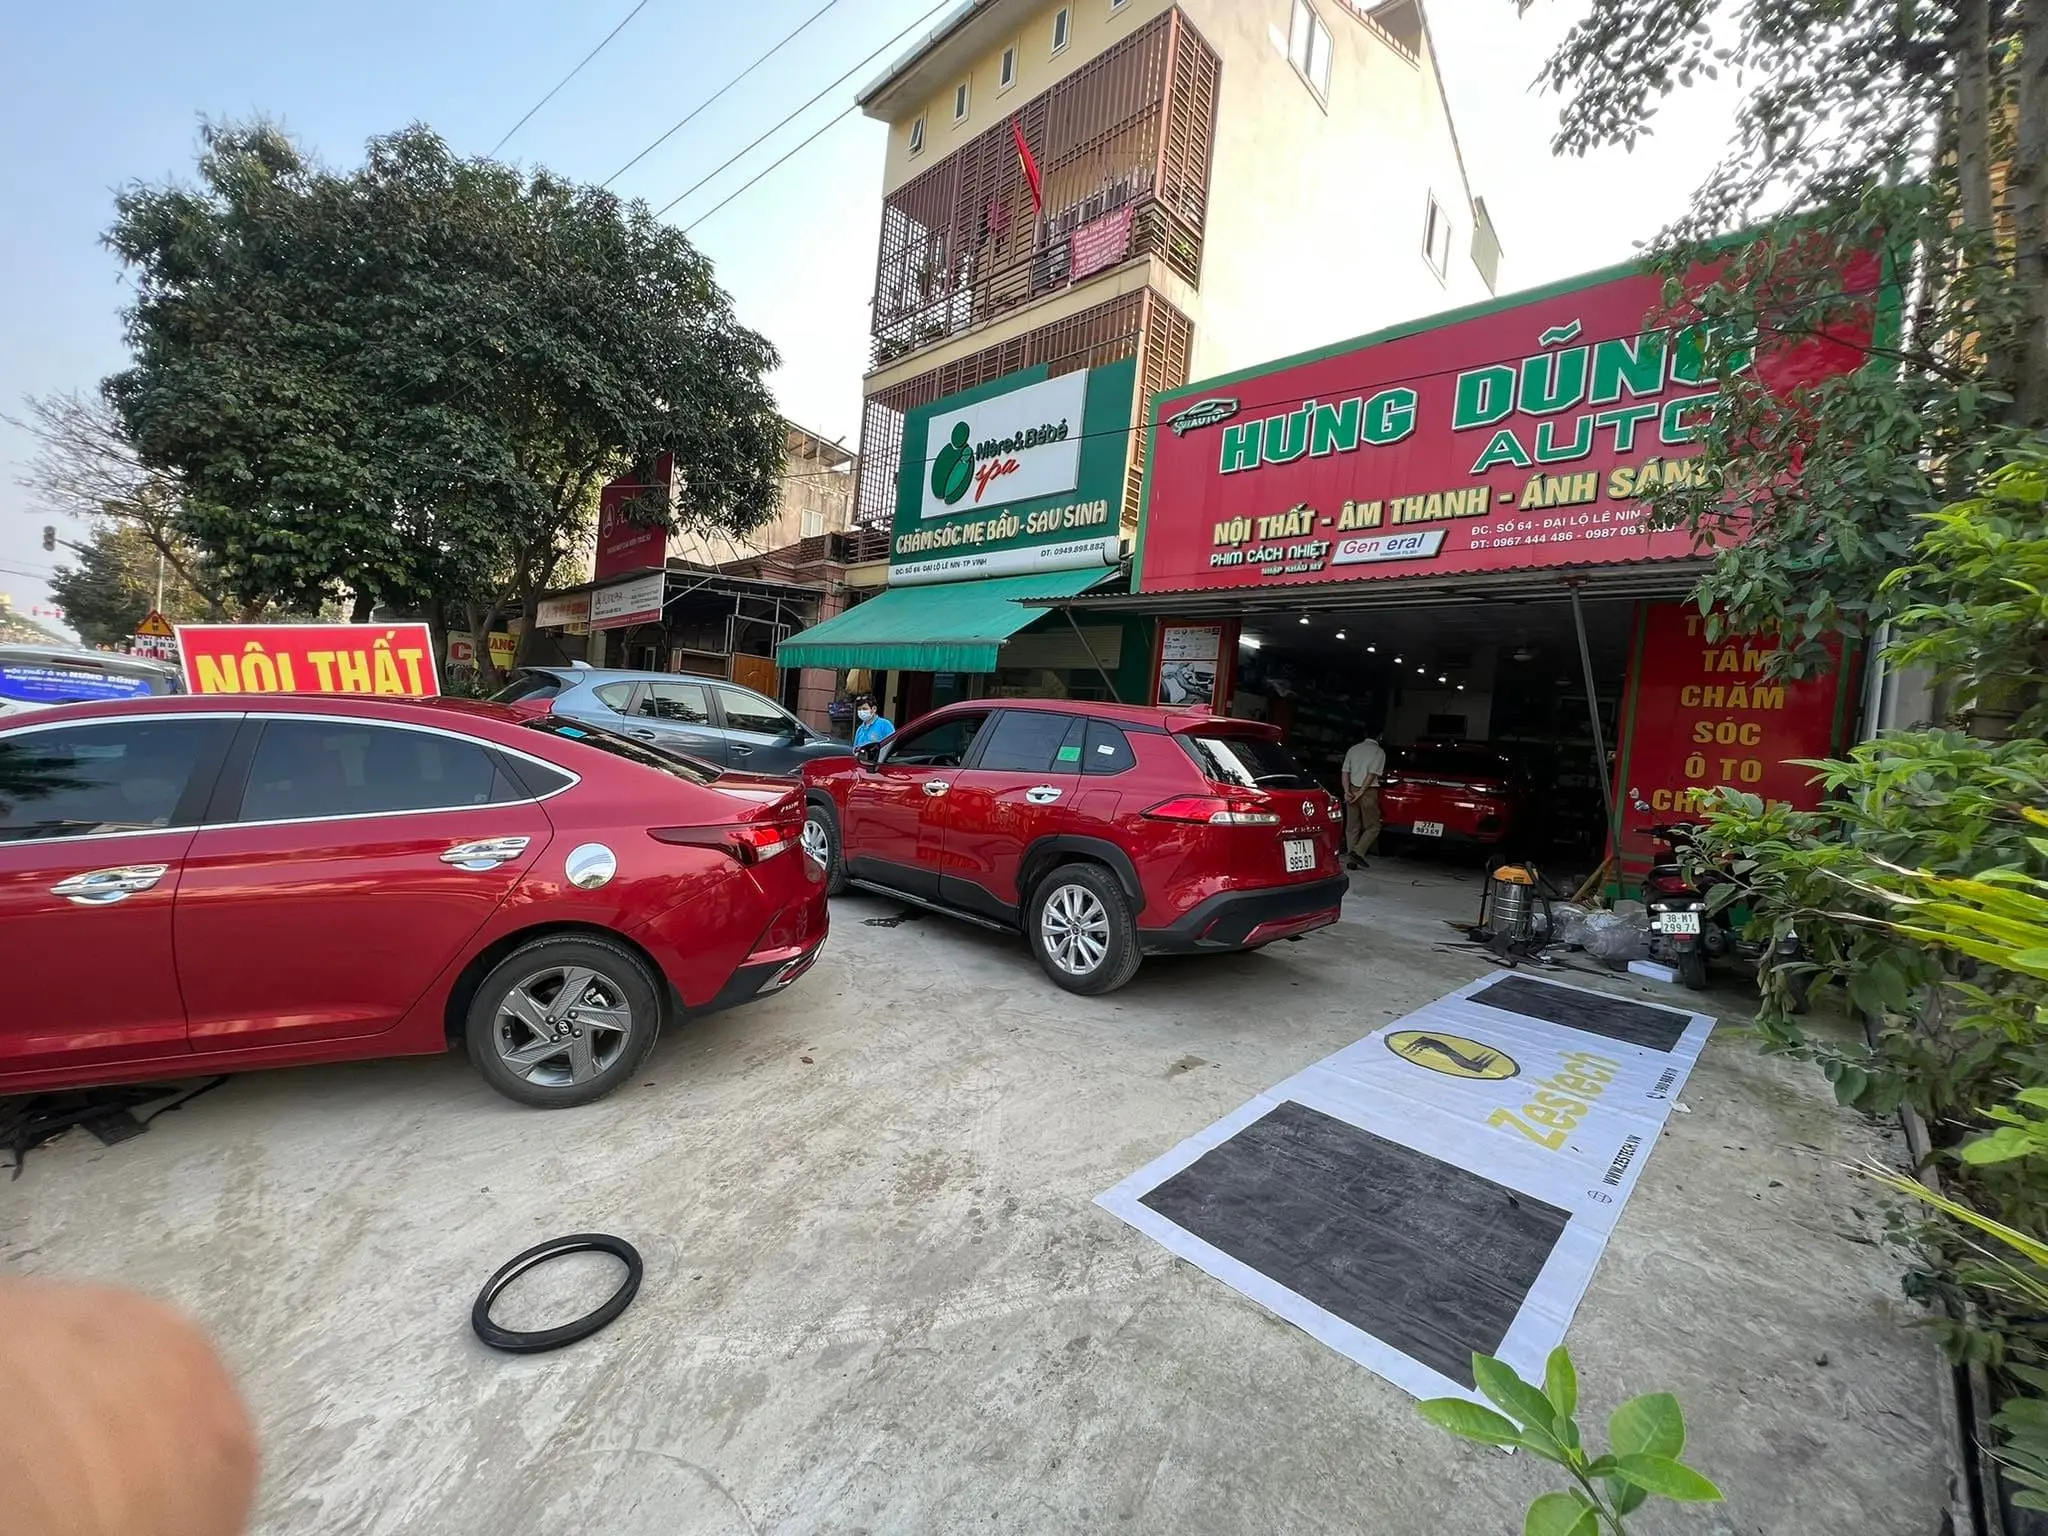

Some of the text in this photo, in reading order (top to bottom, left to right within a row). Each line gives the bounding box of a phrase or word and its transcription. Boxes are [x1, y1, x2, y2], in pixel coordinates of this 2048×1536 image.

[1219, 387, 1418, 474] HƯNG
[1469, 391, 1727, 474] AUTO
[1213, 515, 1252, 548] NỘI
[1257, 502, 1316, 540] THẤT
[1337, 500, 1384, 532] ÂM
[1391, 485, 1491, 523] THANH
[1519, 472, 1600, 512] ÁNH
[1607, 456, 1719, 499] SÁN
[896, 528, 934, 554] CHĂM
[932, 522, 963, 547] SÓC
[962, 522, 987, 547] MẸ
[986, 509, 1020, 541] BẦU
[1026, 507, 1063, 534] SAU
[1063, 499, 1109, 527] SINH
[1496, 518, 1515, 533] SỐ
[1517, 520, 1532, 531] 64
[1543, 517, 1566, 529] ĐẠI
[1569, 512, 1589, 526] LỘ
[1593, 510, 1611, 523] LÊ
[1615, 509, 1641, 521] NIN
[1493, 536, 1521, 548] 0967
[1524, 533, 1546, 545] 444
[1550, 531, 1573, 542] 486
[1585, 527, 1617, 539] 0987
[1210, 540, 1330, 567] PHIM CÁCH NHIỆT
[307, 630, 424, 697] THẤT
[1701, 644, 1776, 673] TÂM
[1681, 680, 1785, 709] CHĂM
[1692, 716, 1762, 746] SÓC
[1684, 751, 1762, 782] Ô TO
[1483, 1050, 1623, 1153] Zestech
